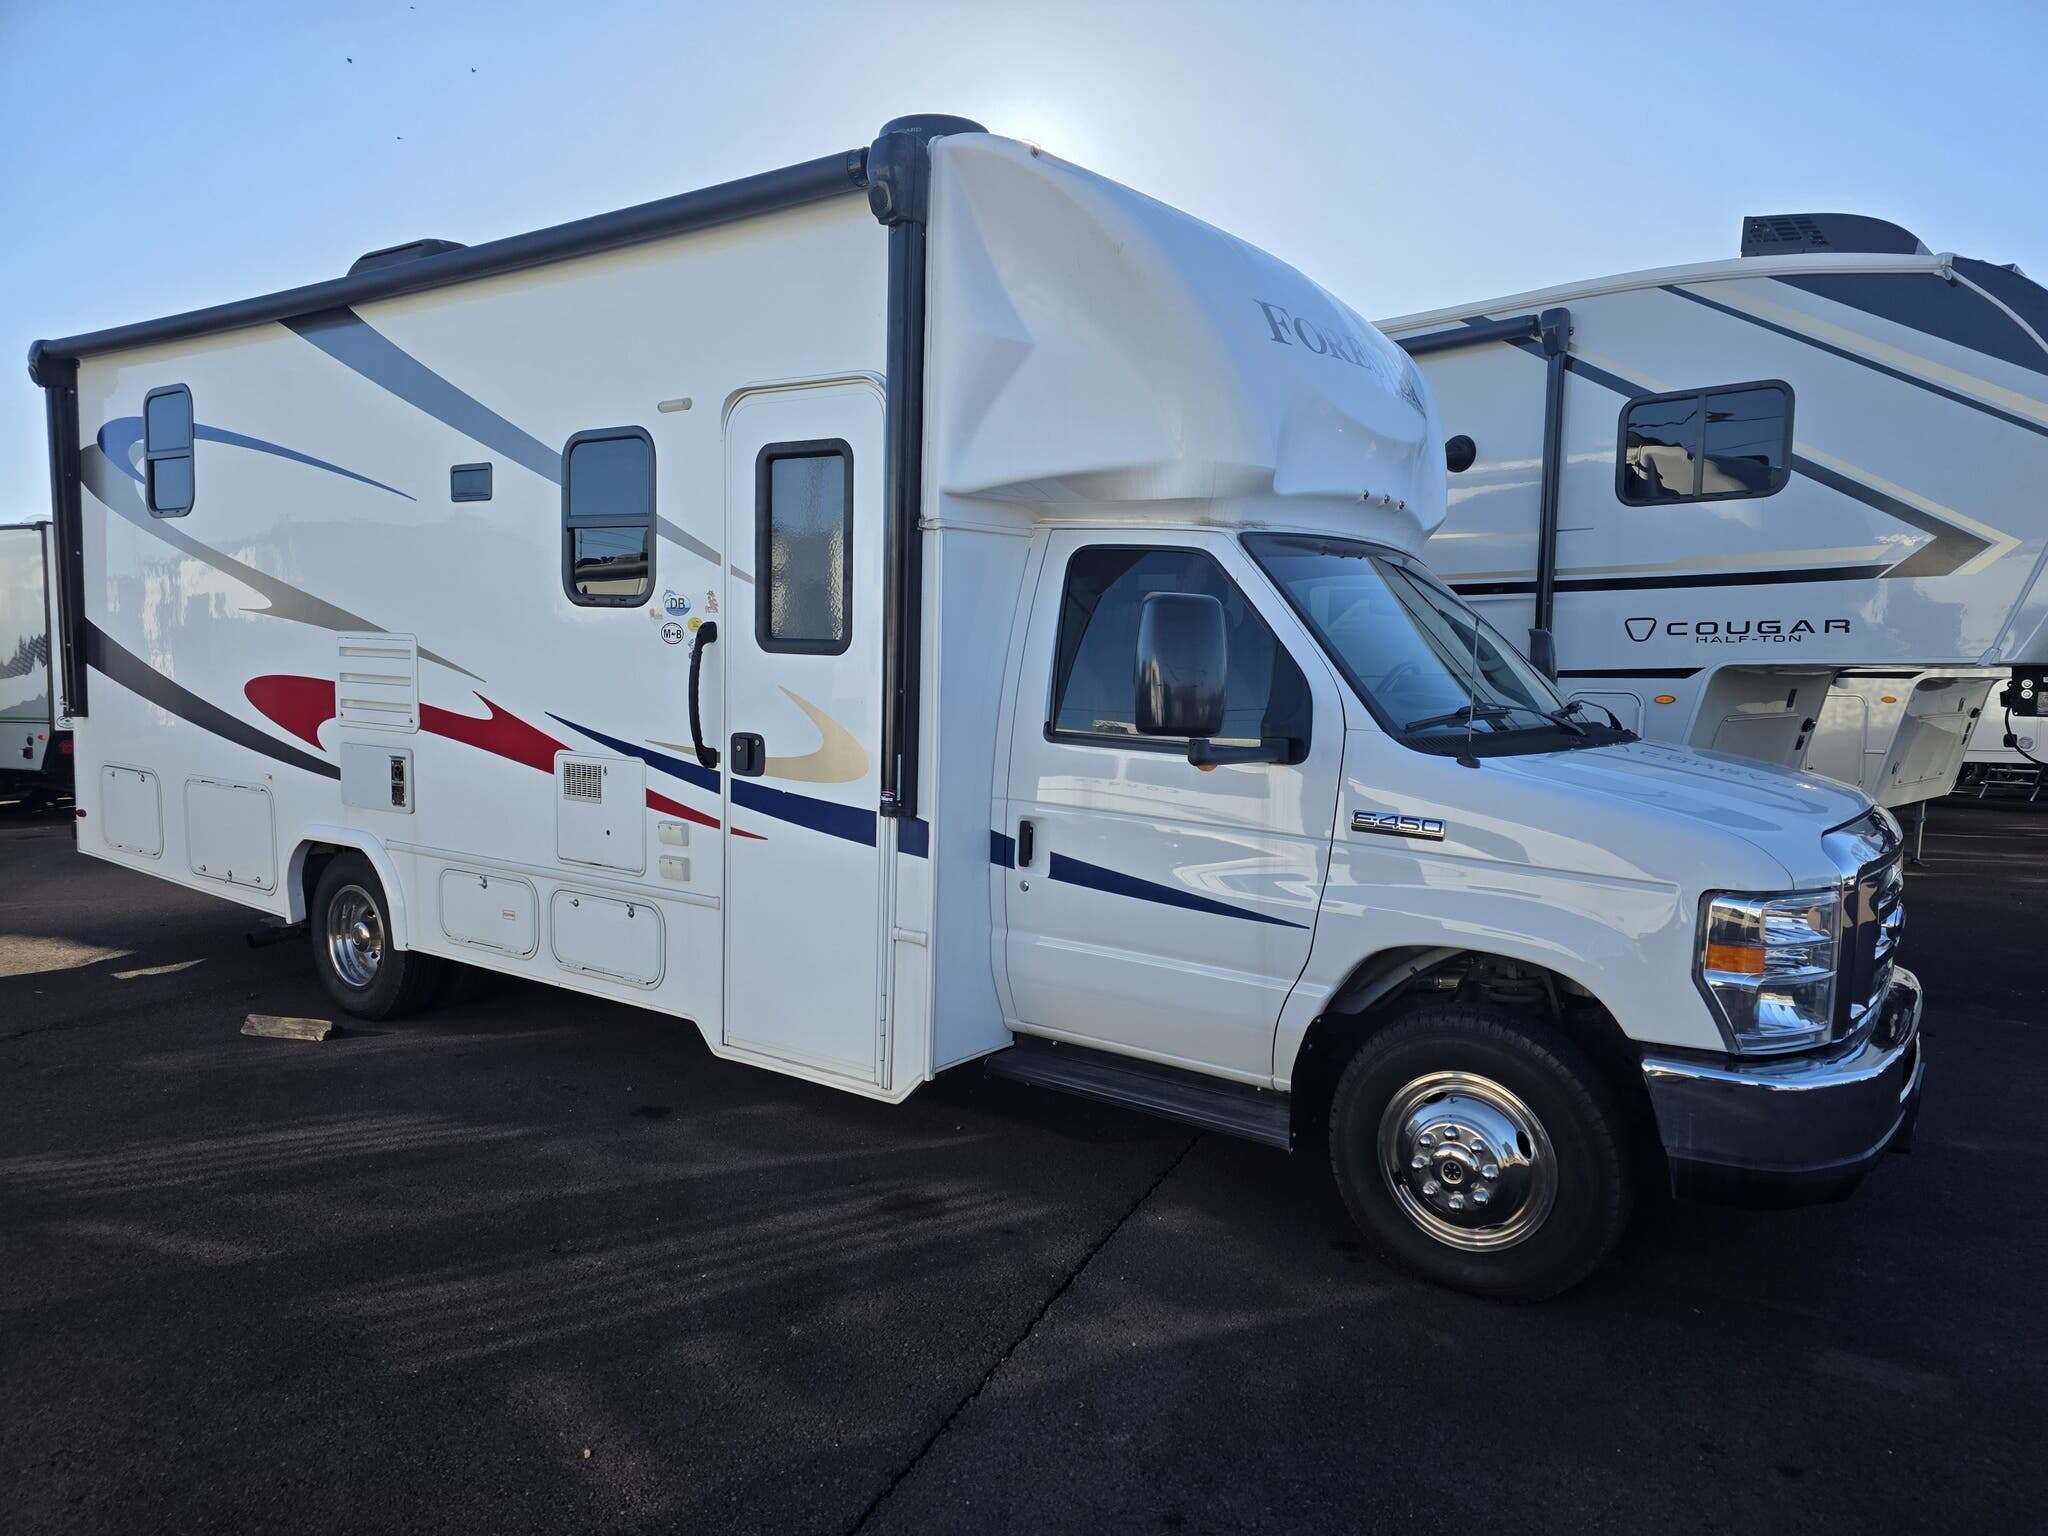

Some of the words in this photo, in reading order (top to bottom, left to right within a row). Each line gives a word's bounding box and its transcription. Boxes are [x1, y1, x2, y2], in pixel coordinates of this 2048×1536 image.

[1666, 619, 1851, 636] COUGAR
[1695, 635, 1802, 644] HALF-TON
[1353, 811, 1443, 833] E-450
